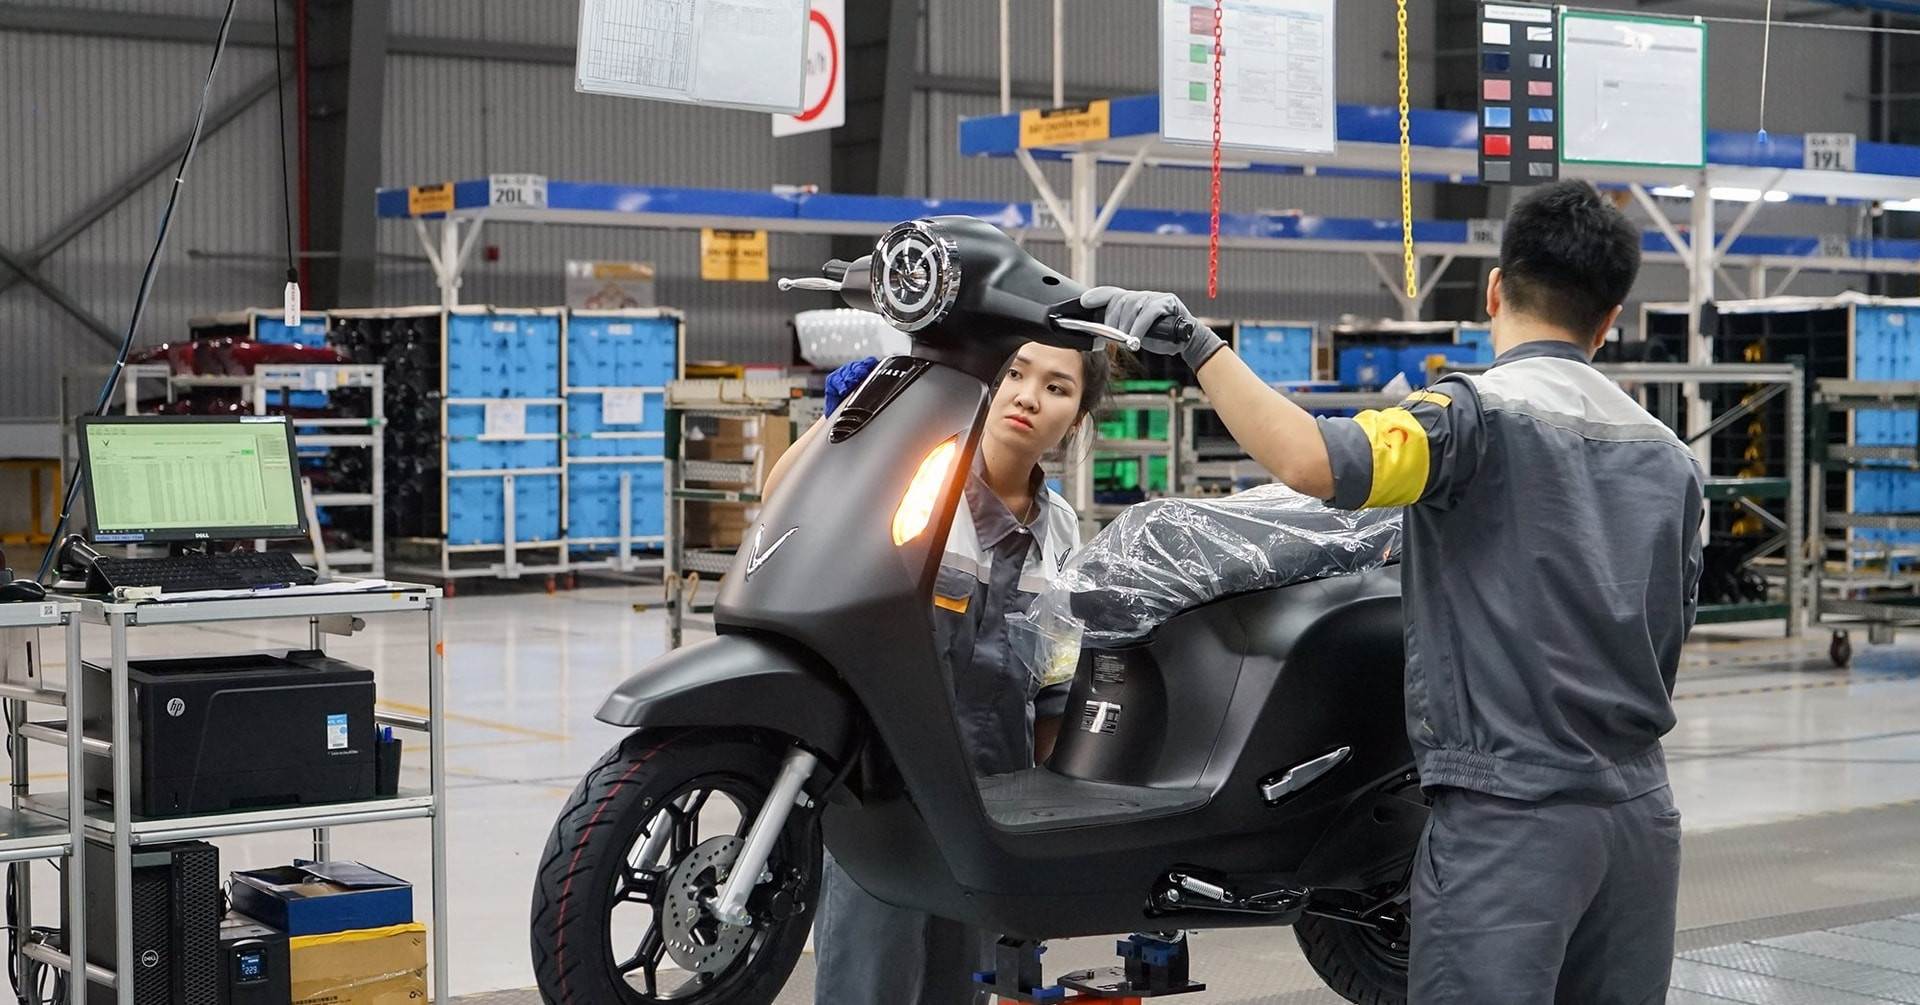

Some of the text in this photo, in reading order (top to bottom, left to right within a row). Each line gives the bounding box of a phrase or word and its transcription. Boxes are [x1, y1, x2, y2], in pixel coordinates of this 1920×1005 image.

[1813, 150, 1846, 170] 19L
[496, 188, 528, 204] 20L
[170, 699, 183, 716] hp
